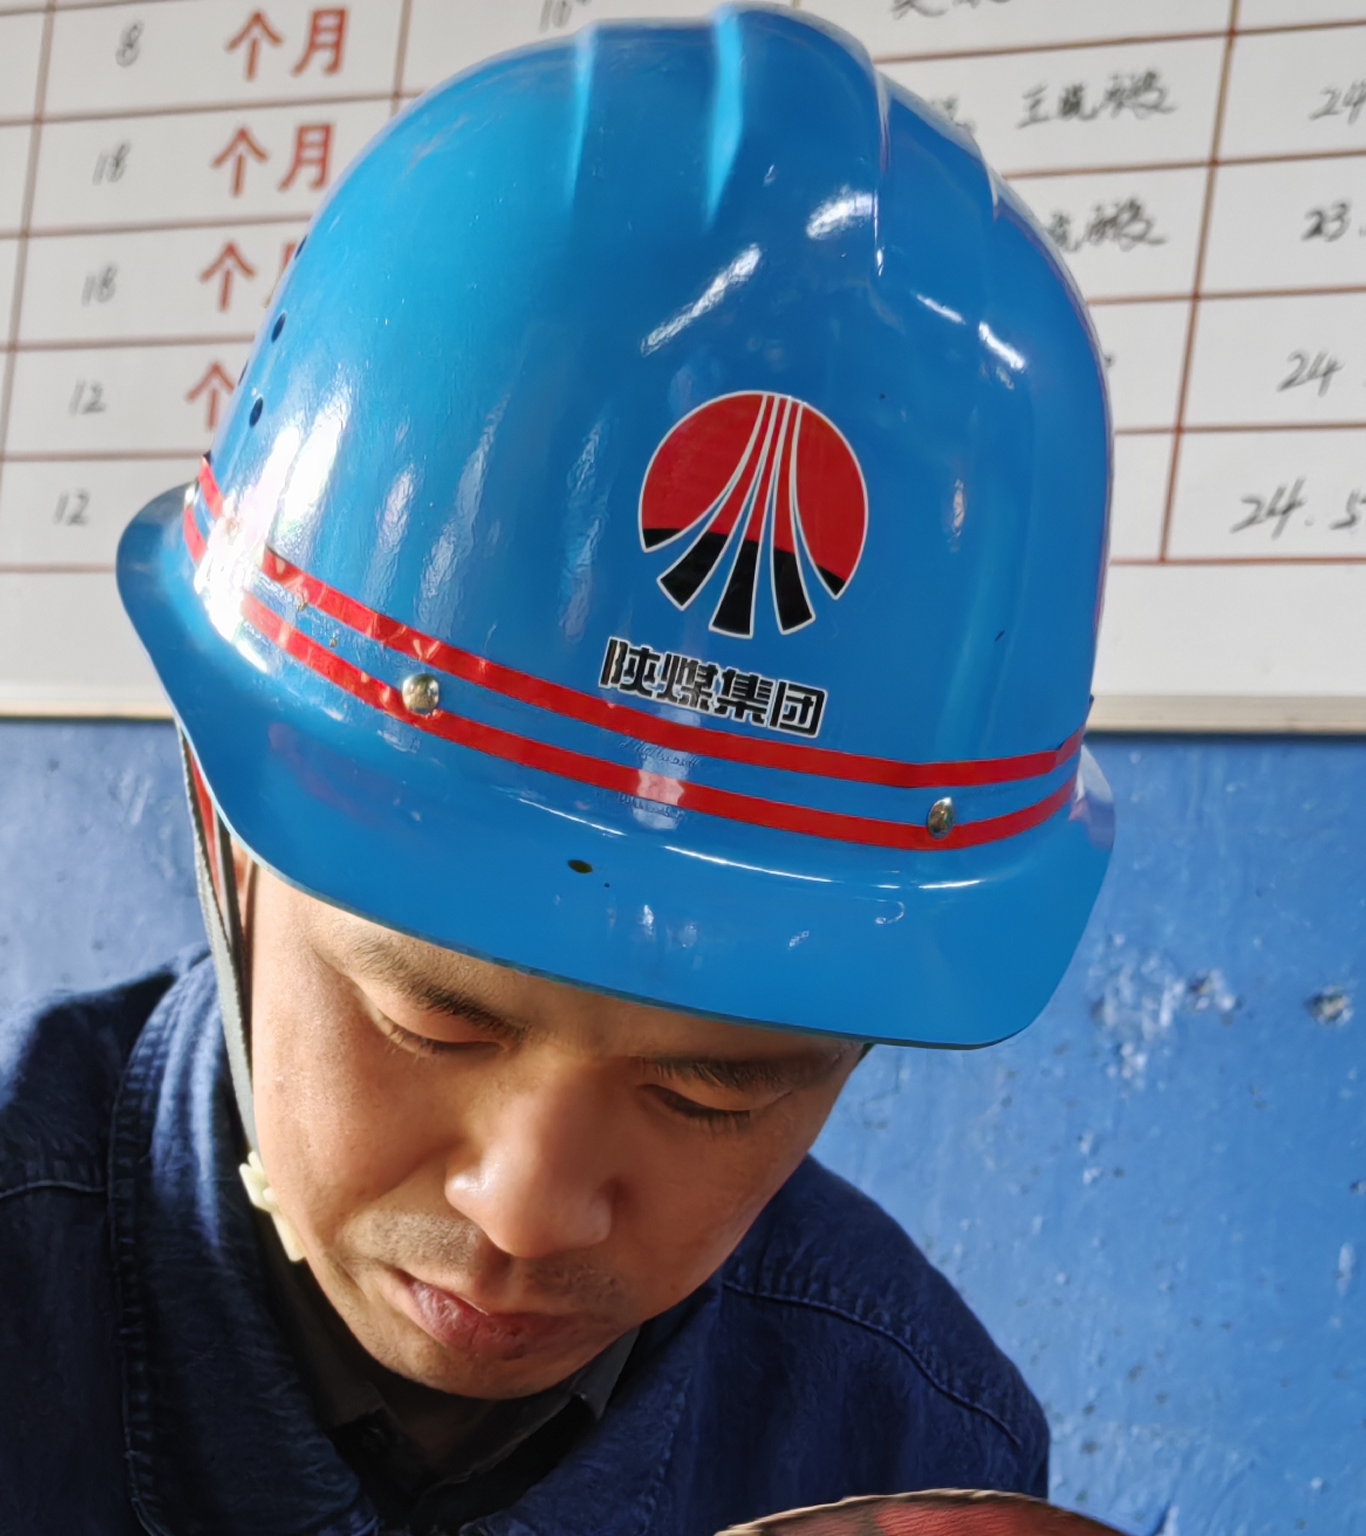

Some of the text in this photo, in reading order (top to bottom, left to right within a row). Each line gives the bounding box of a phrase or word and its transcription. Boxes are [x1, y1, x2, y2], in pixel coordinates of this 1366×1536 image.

[226, 8, 351, 80] 个月
[93, 140, 131, 184] 18
[212, 122, 334, 197] 个月
[81, 263, 119, 305] 18
[199, 241, 299, 313] 个
[68, 379, 107, 416] 12
[52, 488, 91, 526] 12
[598, 636, 829, 739] 陕煤集团
